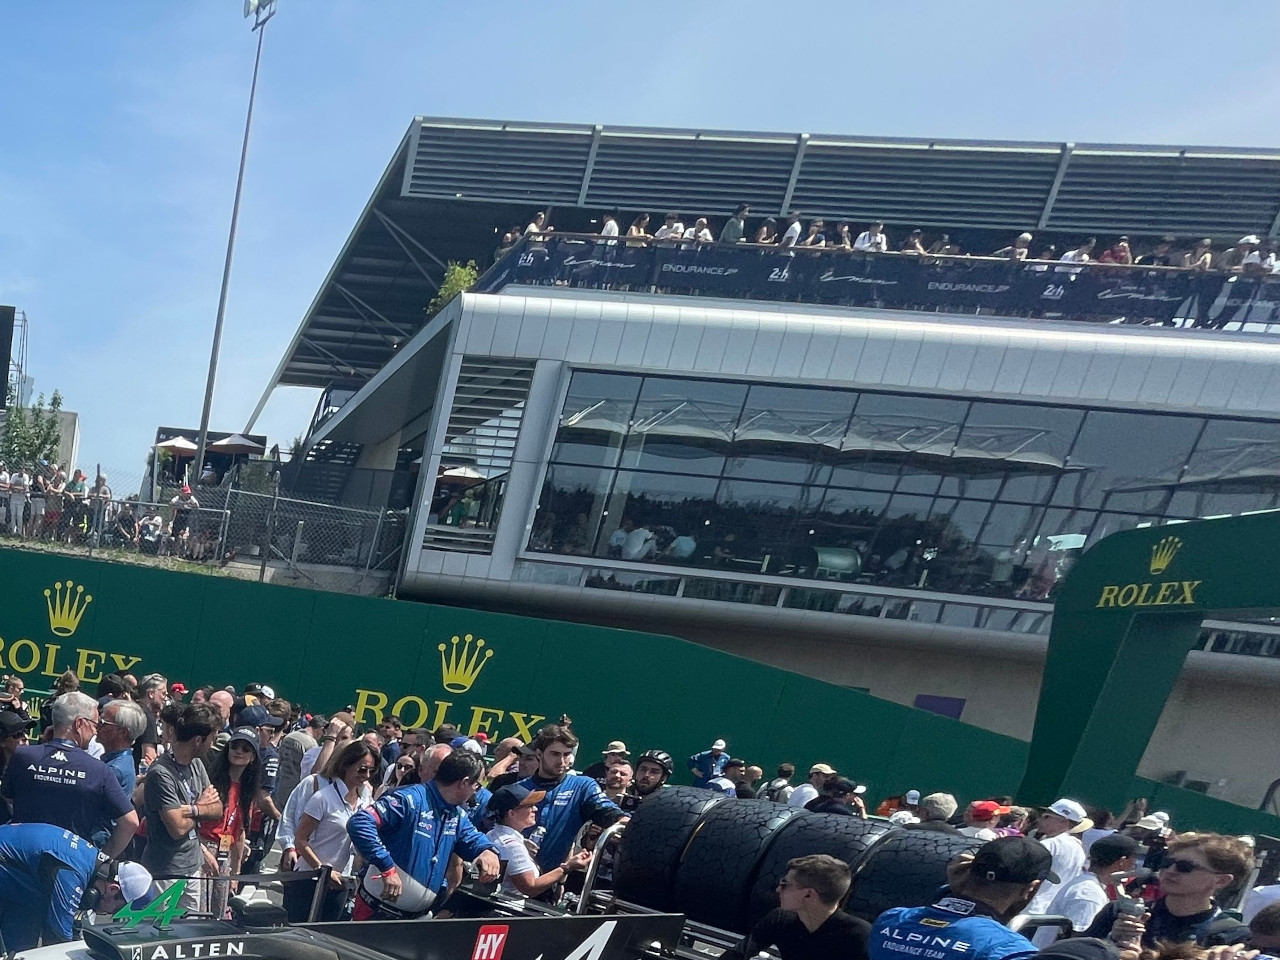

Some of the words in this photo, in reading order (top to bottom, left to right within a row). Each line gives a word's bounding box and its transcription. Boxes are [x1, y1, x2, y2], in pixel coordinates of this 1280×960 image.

[662, 264, 724, 276] ENDURANCE
[928, 282, 996, 293] ENDURANCE
[1096, 581, 1203, 608] ROLEX
[355, 689, 546, 744] ROLEX
[27, 764, 86, 779] ALPINE
[34, 774, 62, 784] ENDURANCE
[474, 934, 505, 960] HY
[880, 927, 971, 953] ALPINE
[151, 942, 244, 960] ALTEN
[883, 940, 921, 956] ENDURANCE
[924, 949, 945, 960] TEAM
